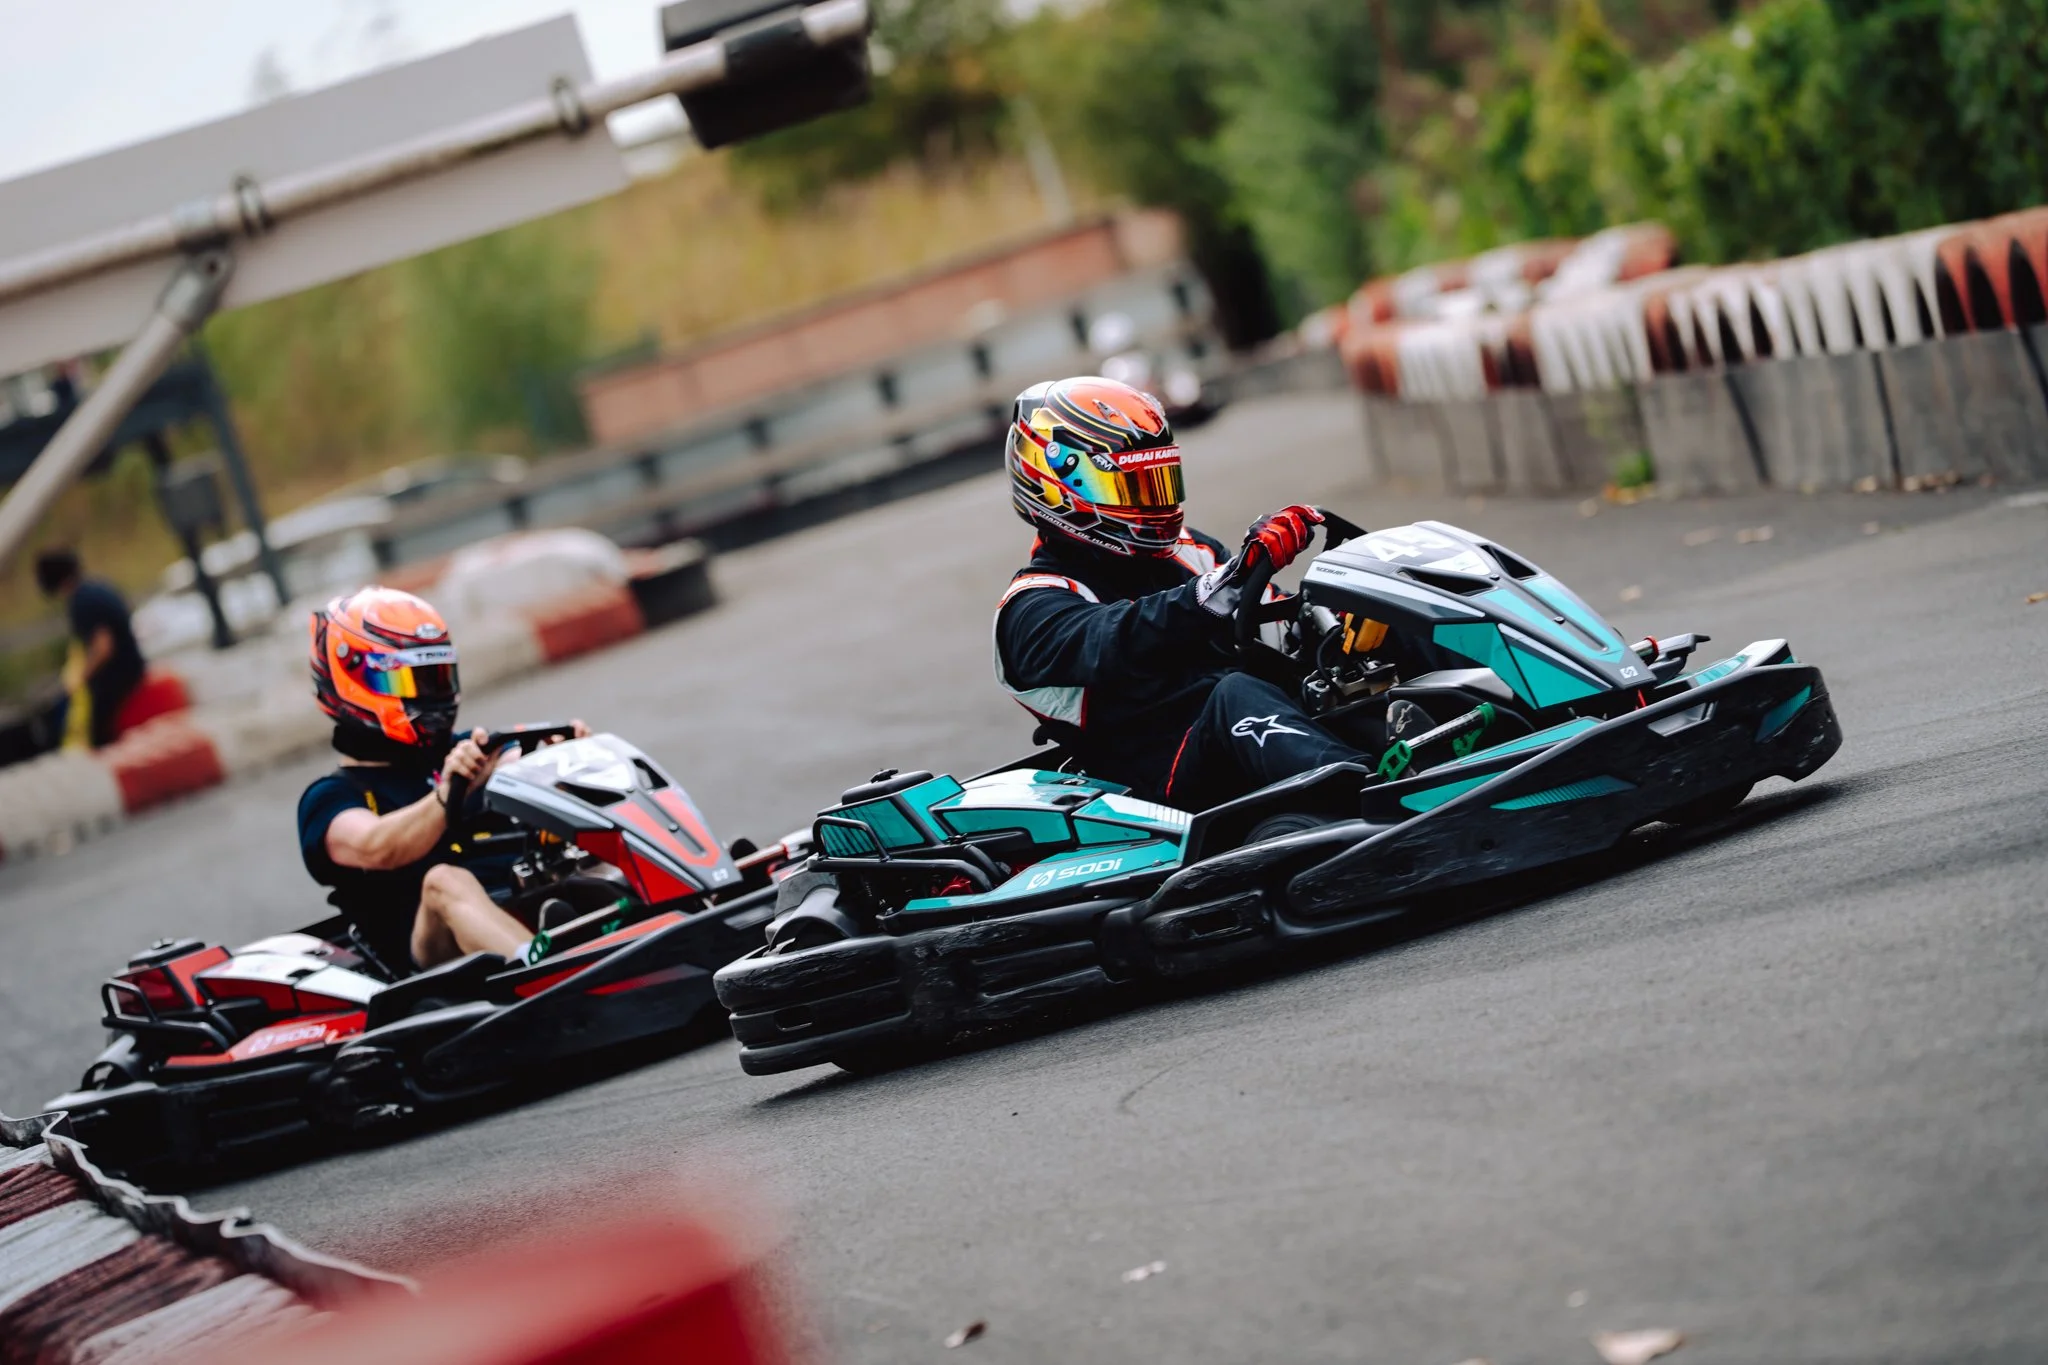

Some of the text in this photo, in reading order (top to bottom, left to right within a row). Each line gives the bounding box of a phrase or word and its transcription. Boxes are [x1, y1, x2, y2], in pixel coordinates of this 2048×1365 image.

[1092, 454, 1113, 470] ARM
[1119, 452, 1154, 466] DUBAI
[1091, 538, 1122, 552] KLEIN
[1057, 858, 1124, 880] SODI
